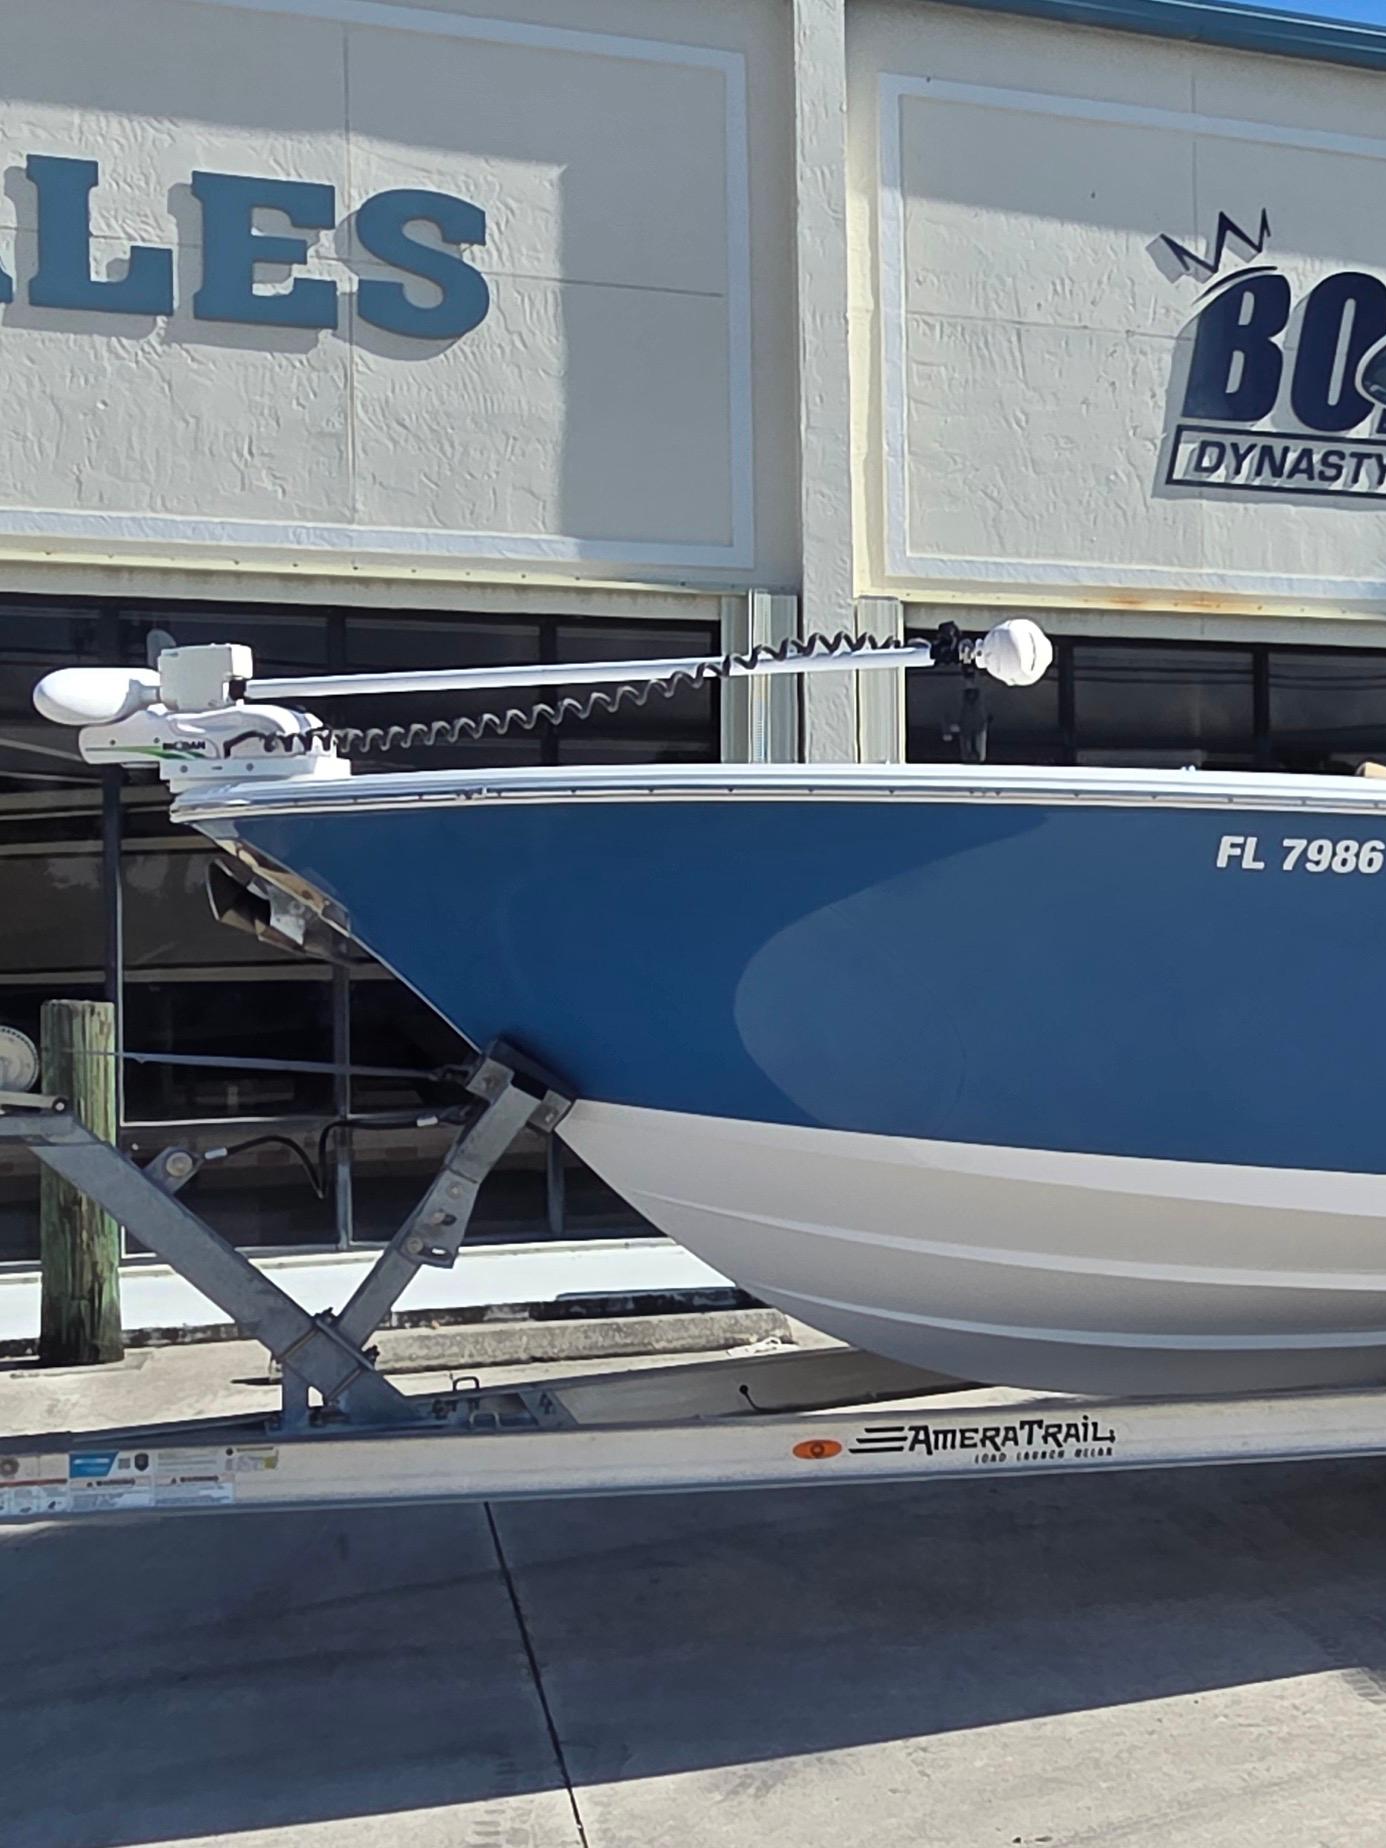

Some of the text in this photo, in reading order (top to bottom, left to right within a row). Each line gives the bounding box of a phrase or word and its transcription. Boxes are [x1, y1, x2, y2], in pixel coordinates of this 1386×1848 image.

[0, 154, 490, 339] LES
[1216, 835, 1265, 871] FL
[1282, 838, 1386, 874] 7986
